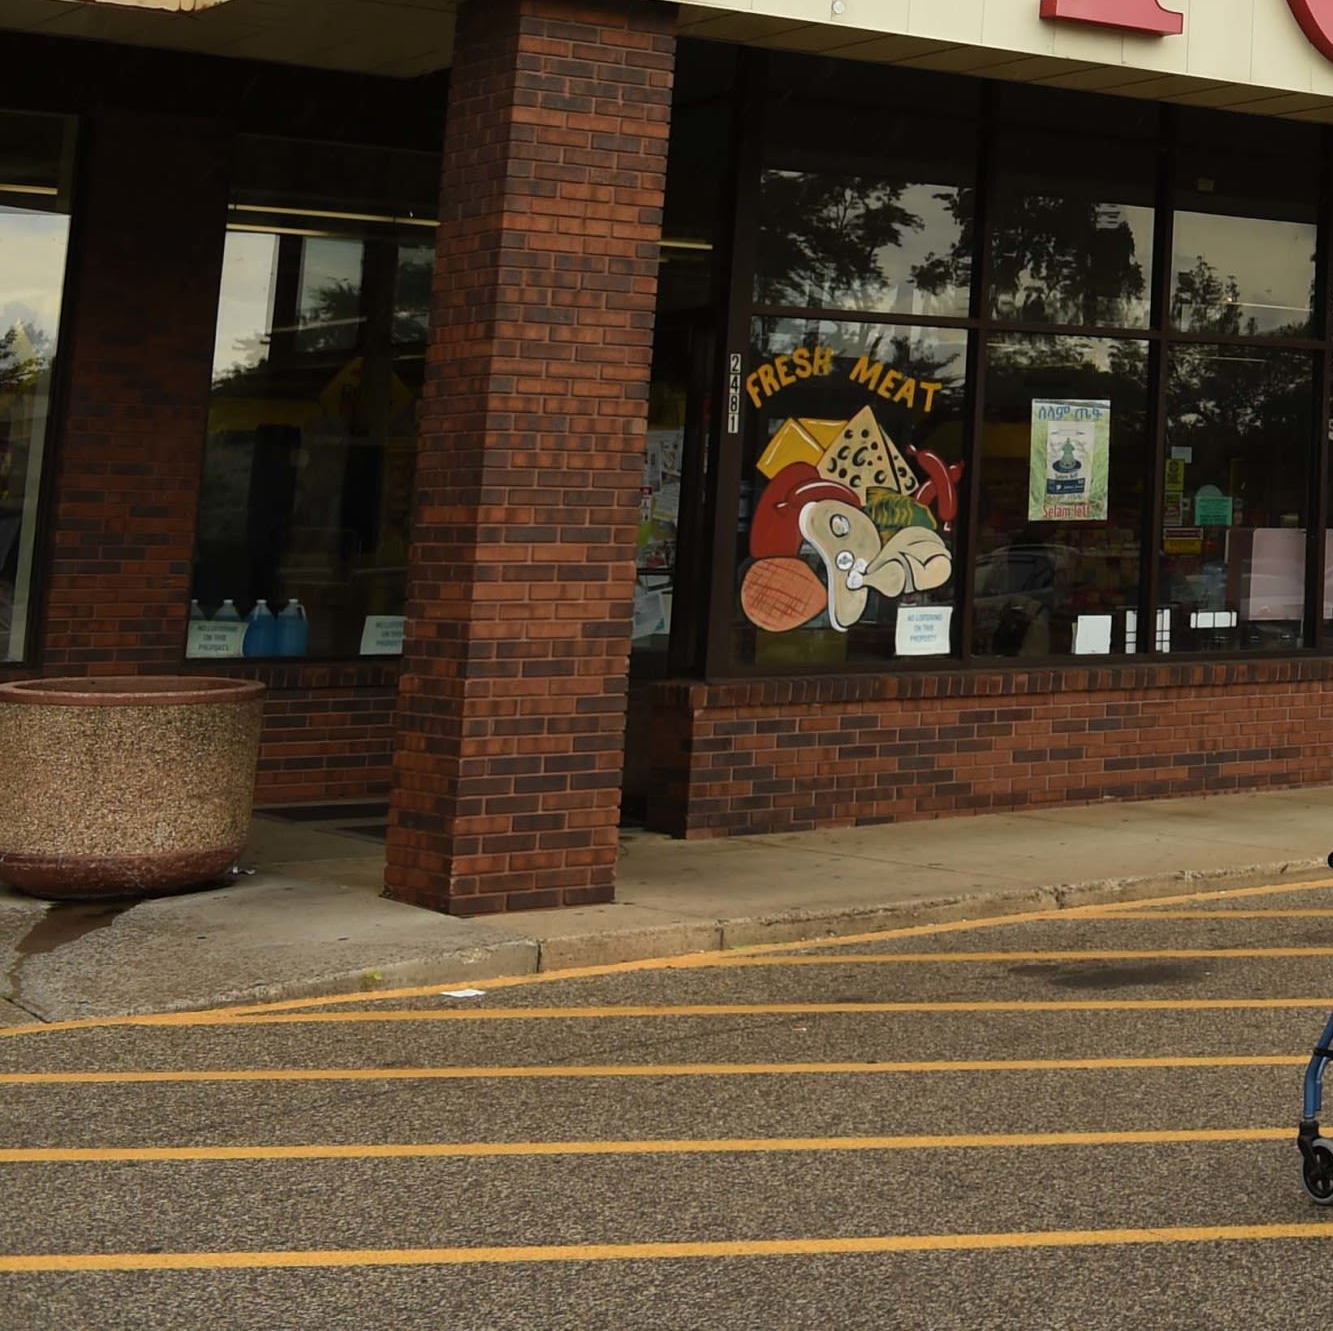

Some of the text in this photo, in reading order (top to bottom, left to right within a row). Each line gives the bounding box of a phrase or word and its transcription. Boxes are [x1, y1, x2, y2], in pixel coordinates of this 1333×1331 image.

[728, 354, 741, 434] 2481
[746, 346, 943, 413] FRESH MEAT
[1043, 504, 1071, 518] Selam
